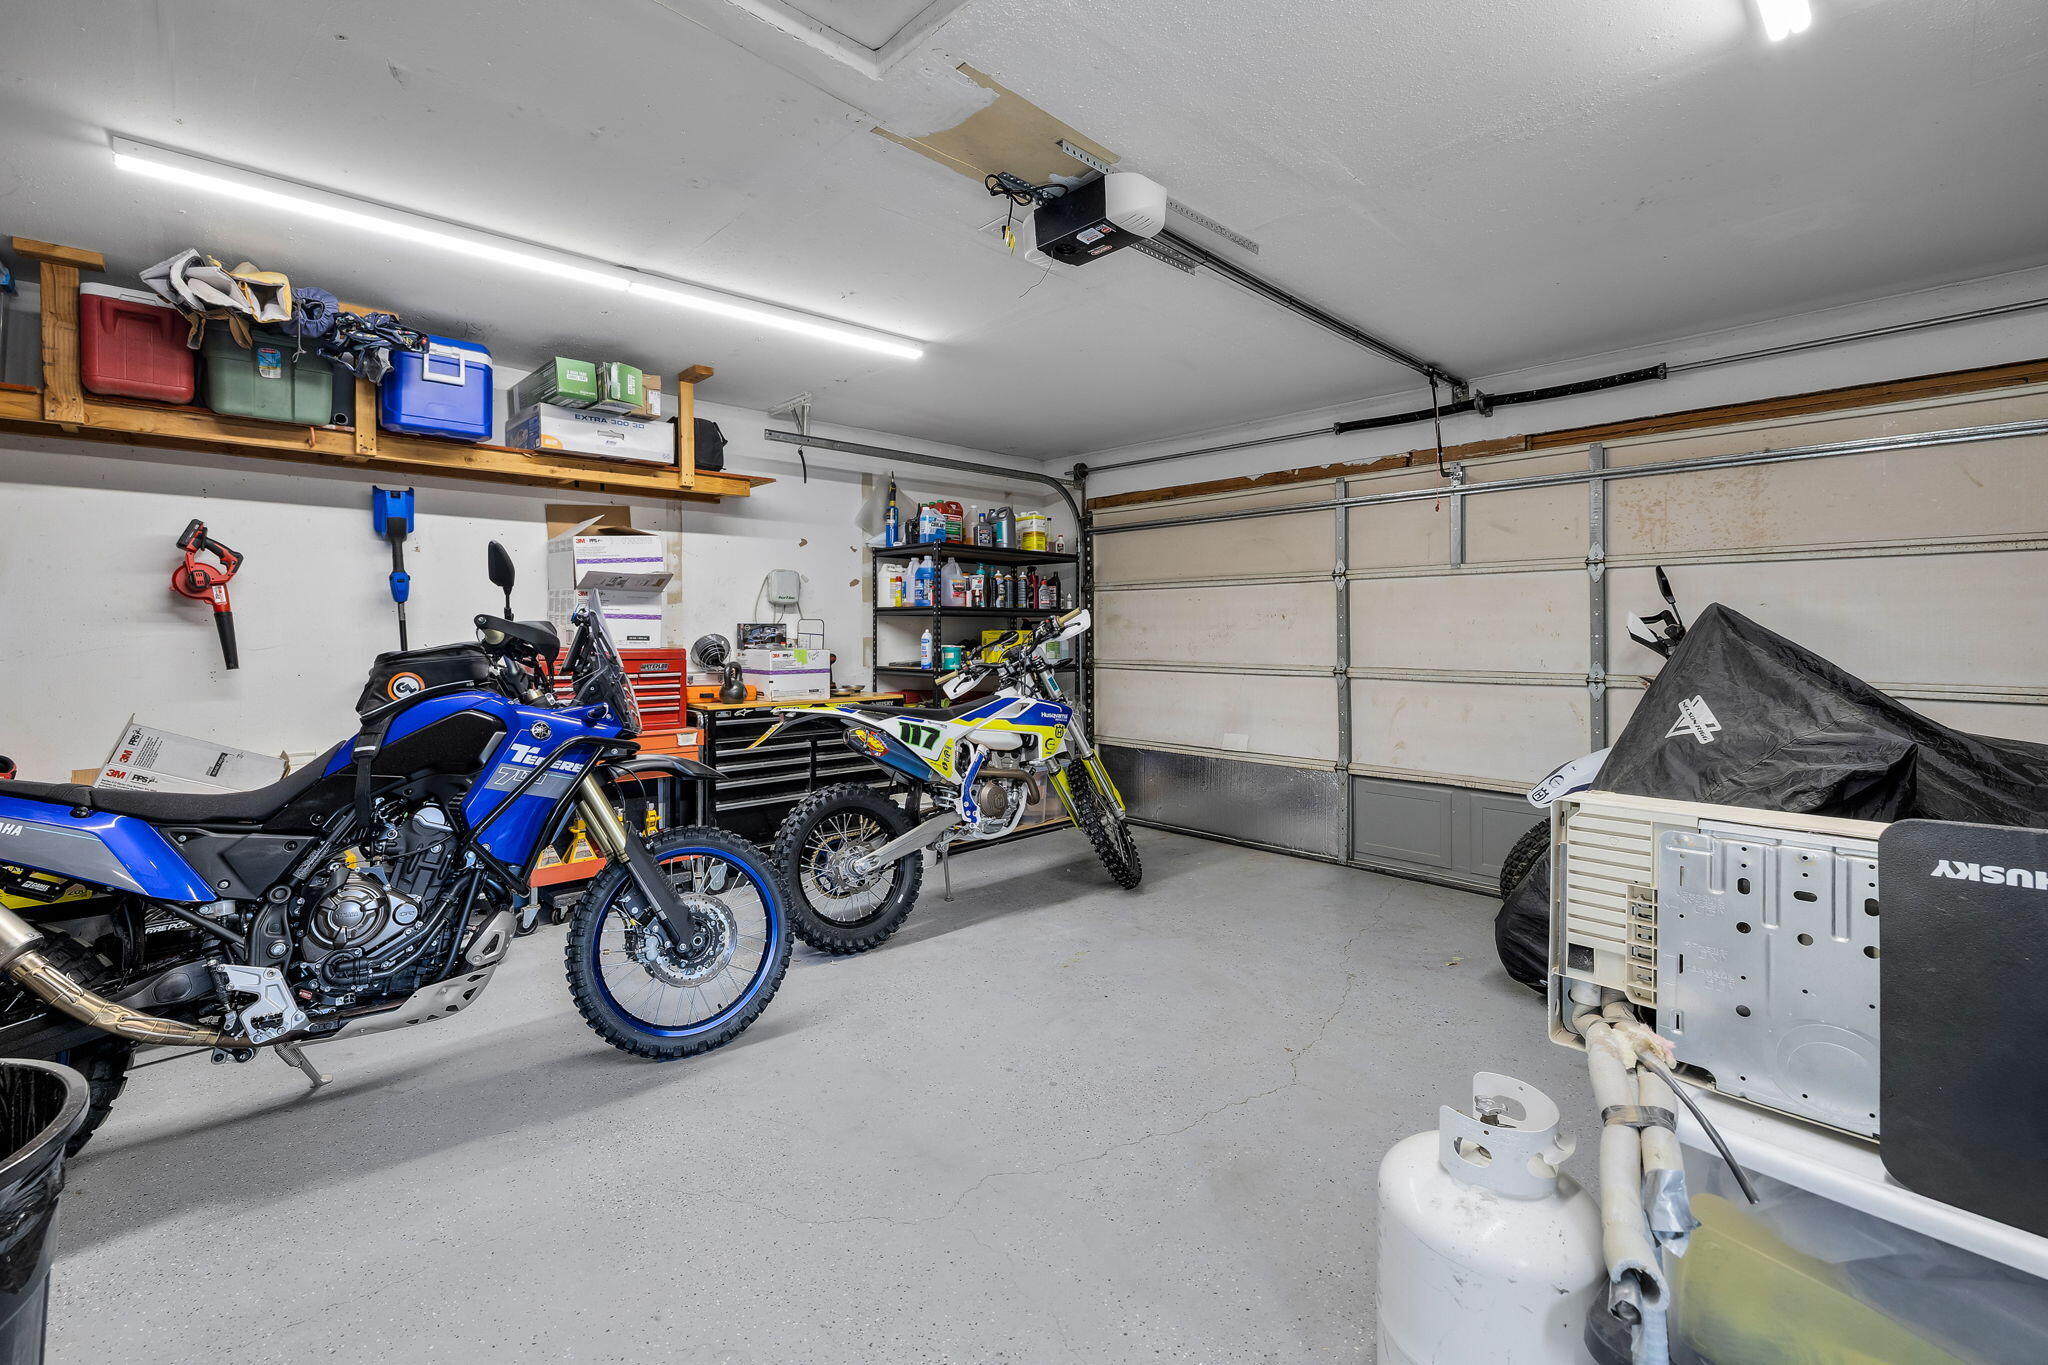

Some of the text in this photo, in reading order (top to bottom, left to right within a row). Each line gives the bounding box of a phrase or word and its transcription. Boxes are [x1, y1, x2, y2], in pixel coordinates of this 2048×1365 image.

[574, 413, 608, 424] EXTRA
[898, 721, 941, 751] 117
[119, 749, 134, 764] 3M
[105, 768, 149, 784] 3M PPS
